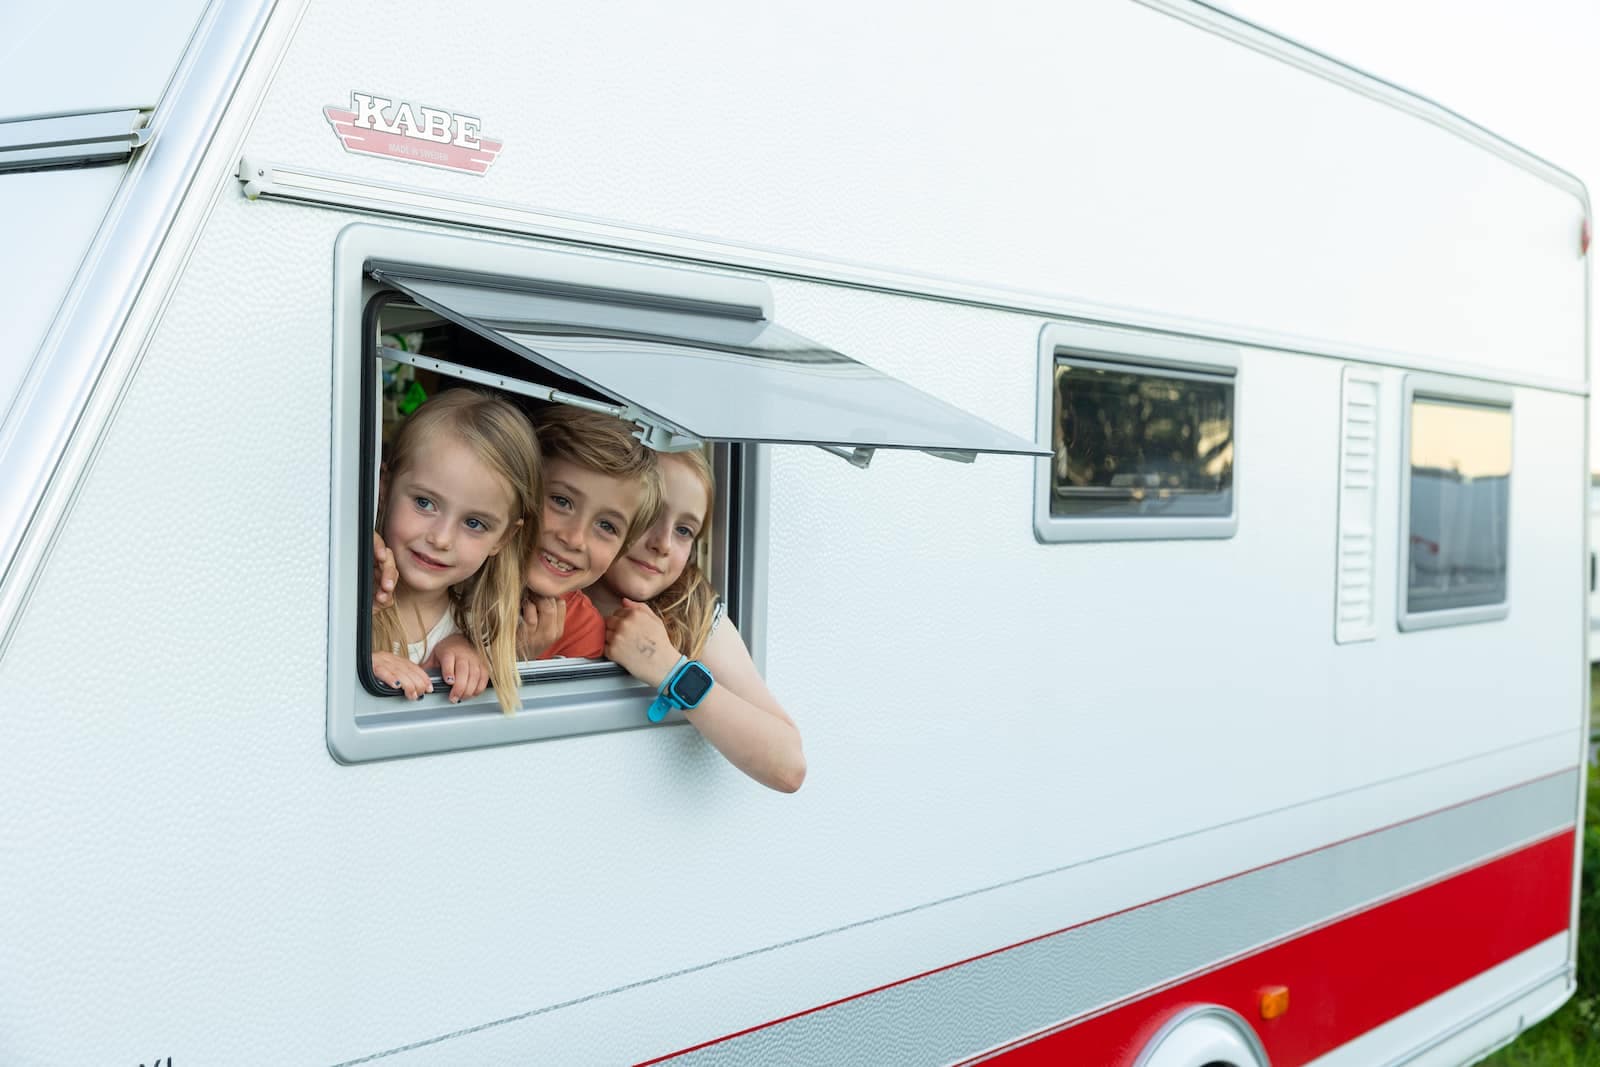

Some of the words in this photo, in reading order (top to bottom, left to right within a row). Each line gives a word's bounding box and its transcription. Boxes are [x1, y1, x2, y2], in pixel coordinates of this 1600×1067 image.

[353, 92, 481, 151] KABE
[388, 143, 411, 155] MADE
[420, 149, 448, 161] SWEDEN
